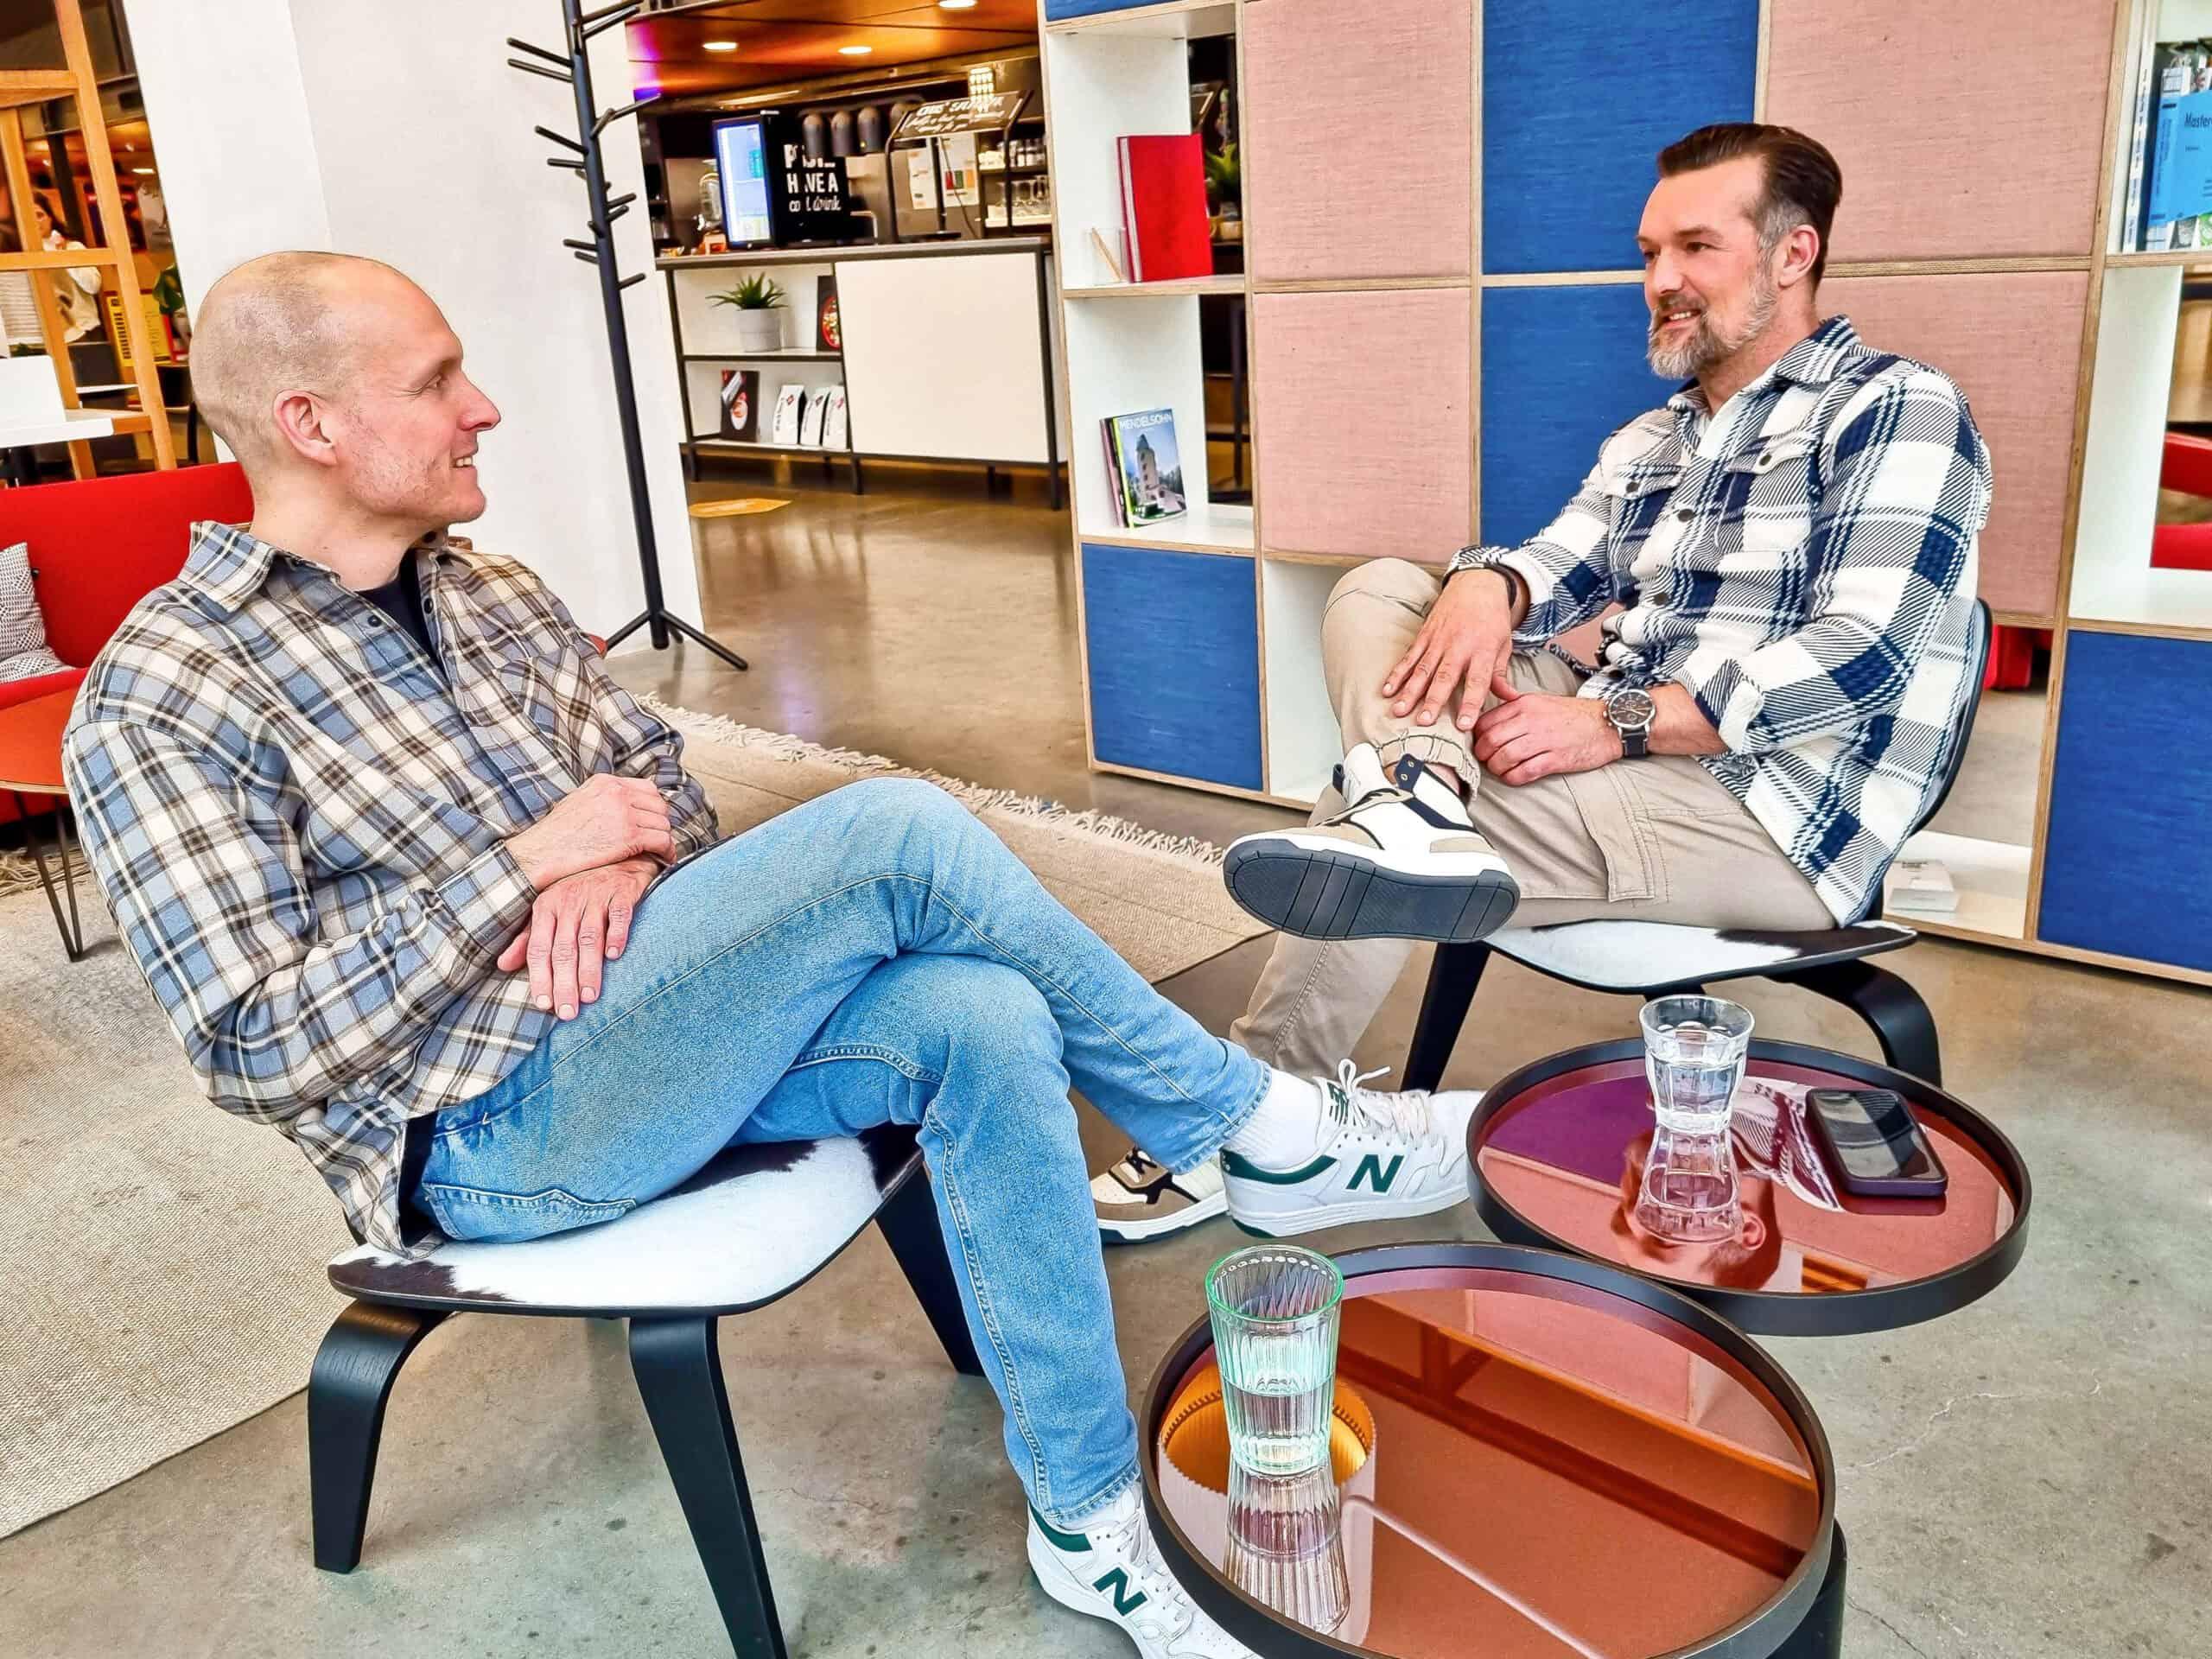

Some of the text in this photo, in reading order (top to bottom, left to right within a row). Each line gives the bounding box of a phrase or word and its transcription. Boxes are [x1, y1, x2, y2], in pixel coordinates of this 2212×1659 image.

[786, 173, 838, 193] HVE A
[1345, 1154, 1404, 1192] N
[1092, 1567, 1147, 1616] N
